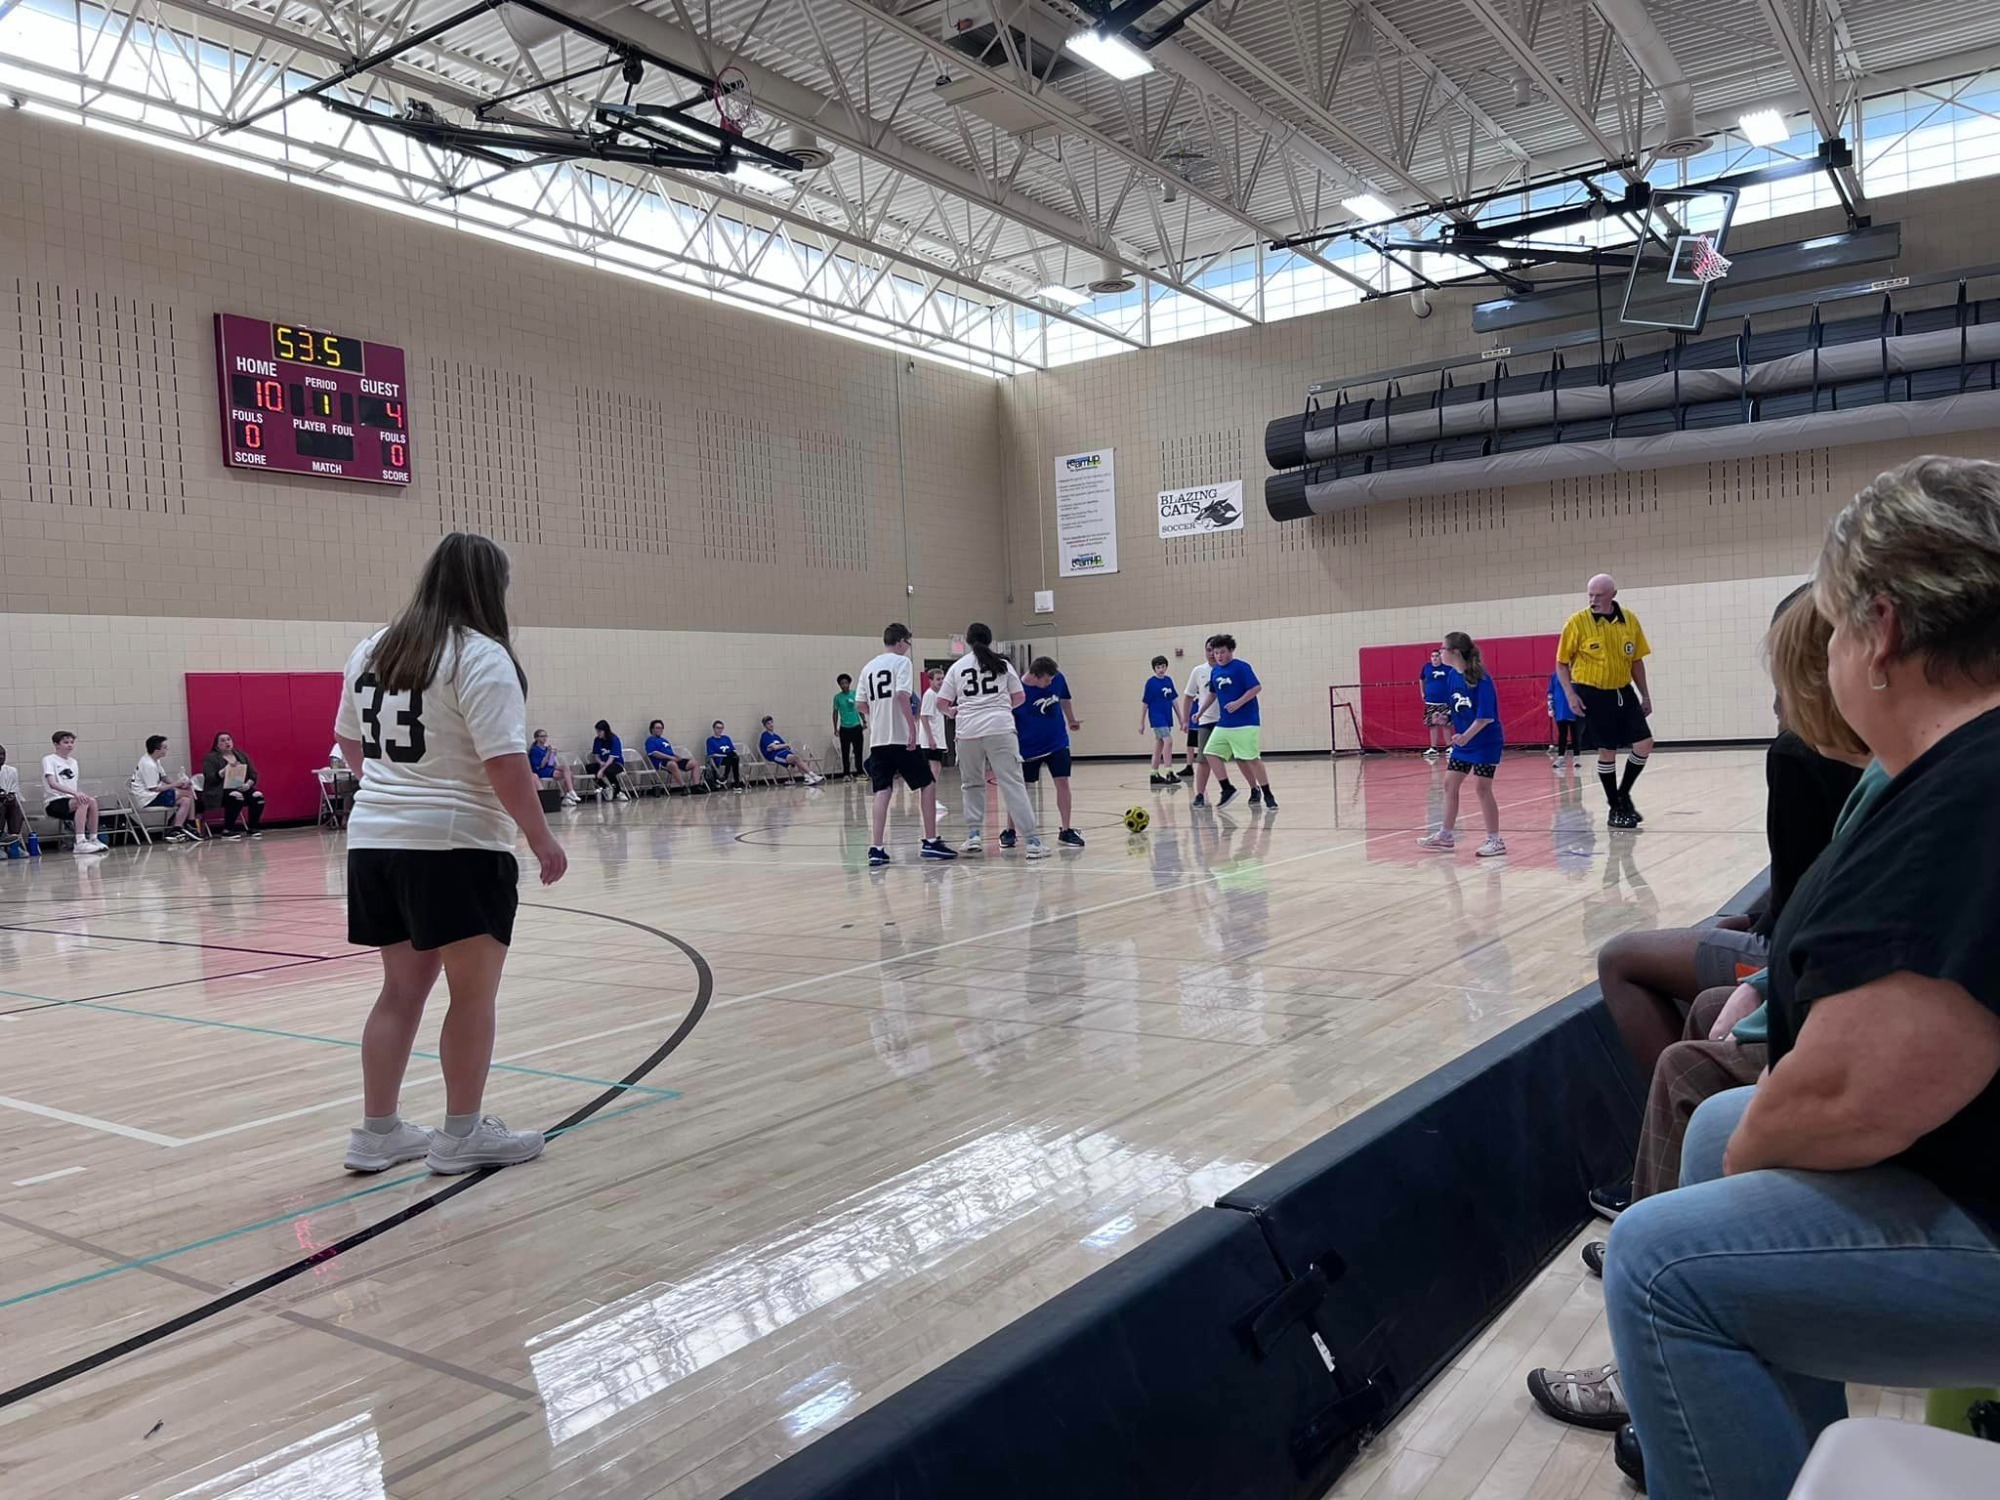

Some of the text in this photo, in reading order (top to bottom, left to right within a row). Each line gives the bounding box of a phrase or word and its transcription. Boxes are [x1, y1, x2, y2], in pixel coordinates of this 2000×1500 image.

[276, 327, 341, 367] 53.5
[236, 356, 278, 378] HOME
[305, 376, 337, 391] PERIOD
[360, 378, 400, 397] GUEST
[256, 381, 283, 412] 10
[323, 394, 330, 415] 1
[232, 409, 263, 424] FOULS
[386, 402, 402, 428] 4
[245, 424, 261, 448] 0
[293, 418, 355, 437] PLAYER FOUL
[380, 431, 406, 444] FOULS
[235, 451, 267, 465] SCORE
[390, 444, 404, 467] 0
[312, 461, 342, 474] MATCH
[382, 469, 409, 482] SCORE
[1160, 489, 1217, 505] BLAZING
[1161, 501, 1200, 517] CATS
[1161, 522, 1196, 533] SOCCER
[867, 669, 893, 701] 12
[960, 667, 999, 697] 32
[354, 672, 426, 763] 33
